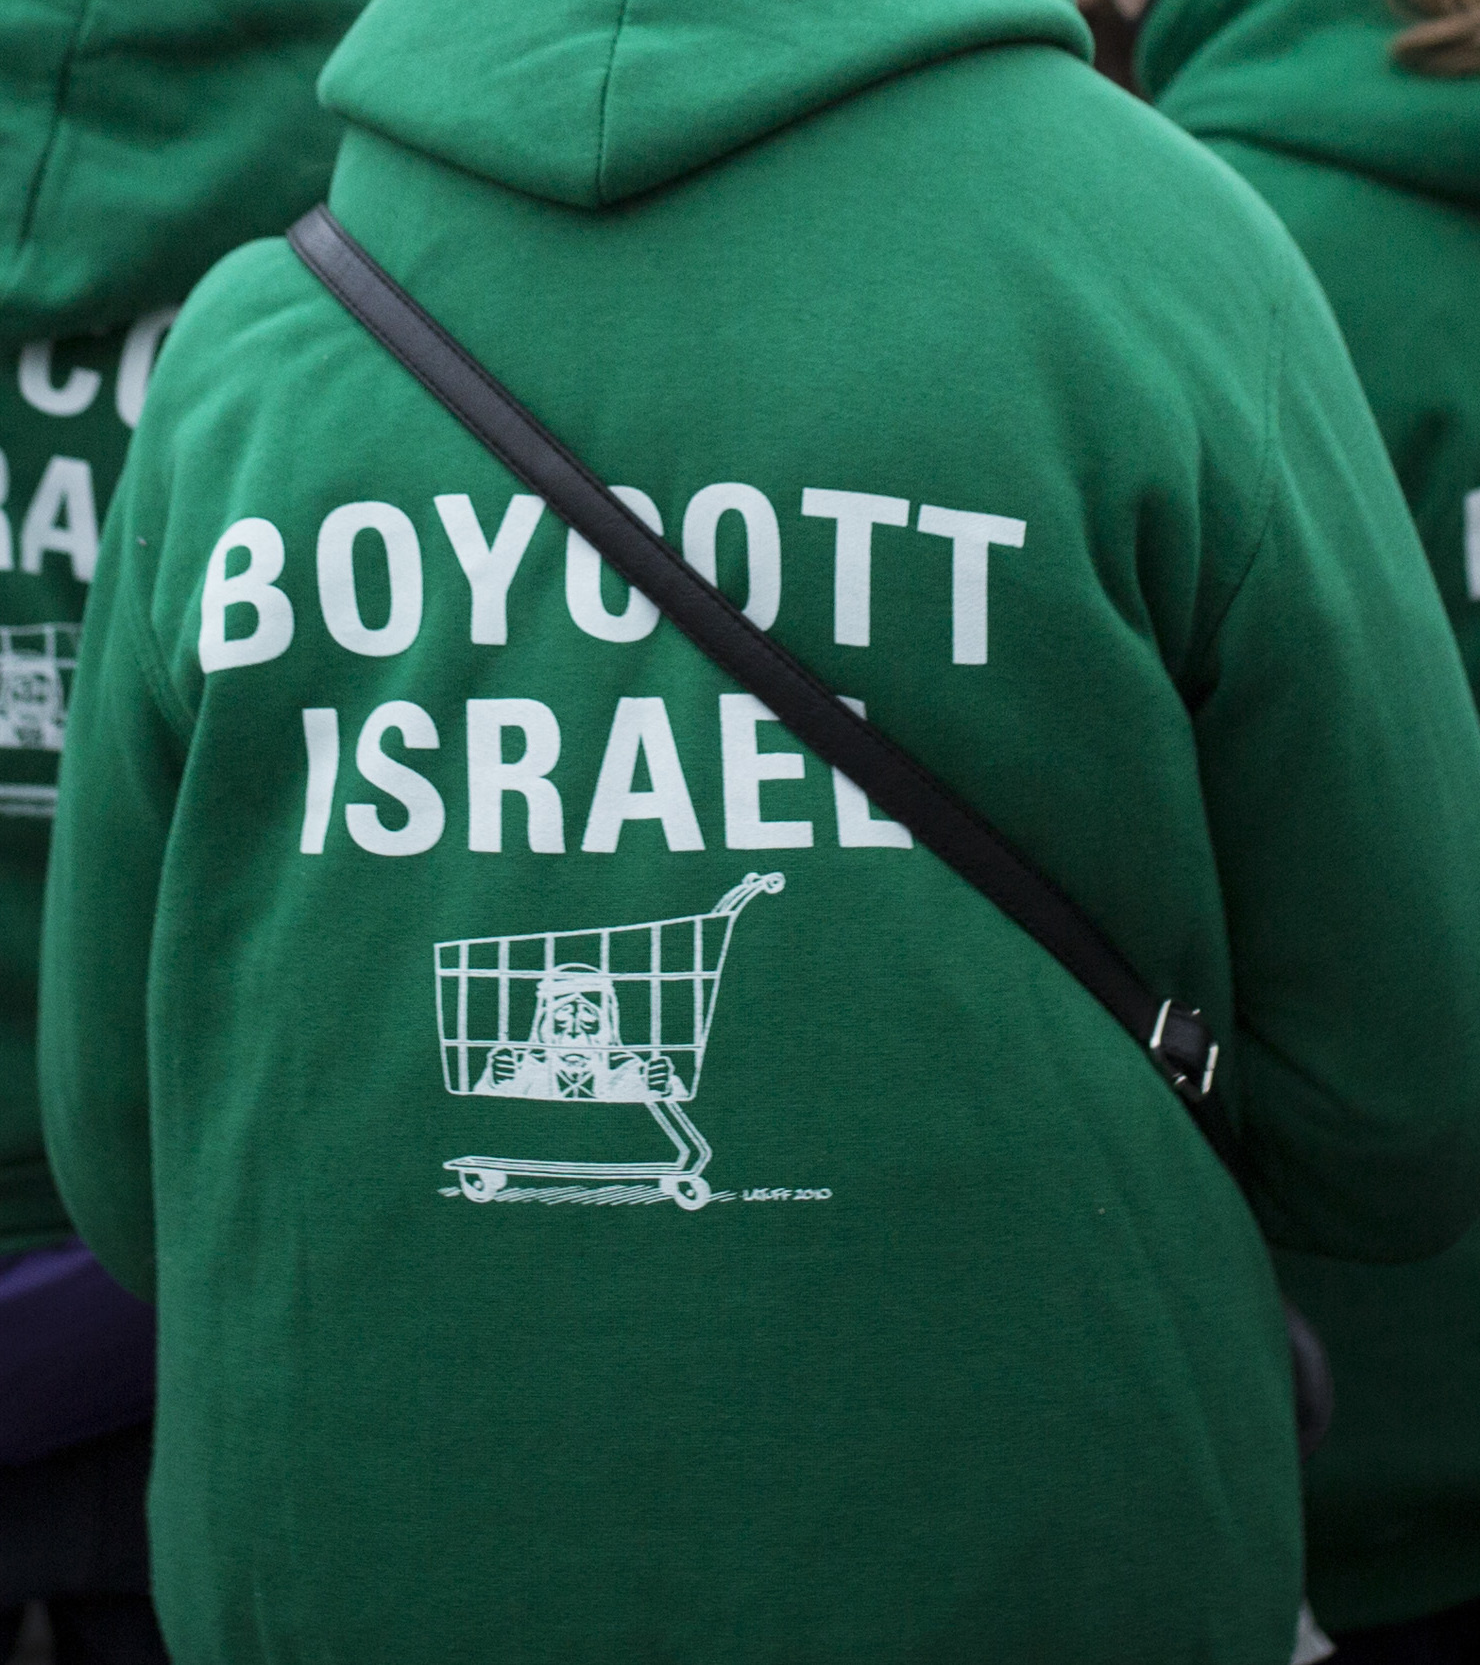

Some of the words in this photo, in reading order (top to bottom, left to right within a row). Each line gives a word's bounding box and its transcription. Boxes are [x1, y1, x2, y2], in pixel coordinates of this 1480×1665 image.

[198, 481, 1027, 674] BOYCOTT
[299, 693, 914, 856] ISRAEL
[792, 1187, 833, 1201] 2010
